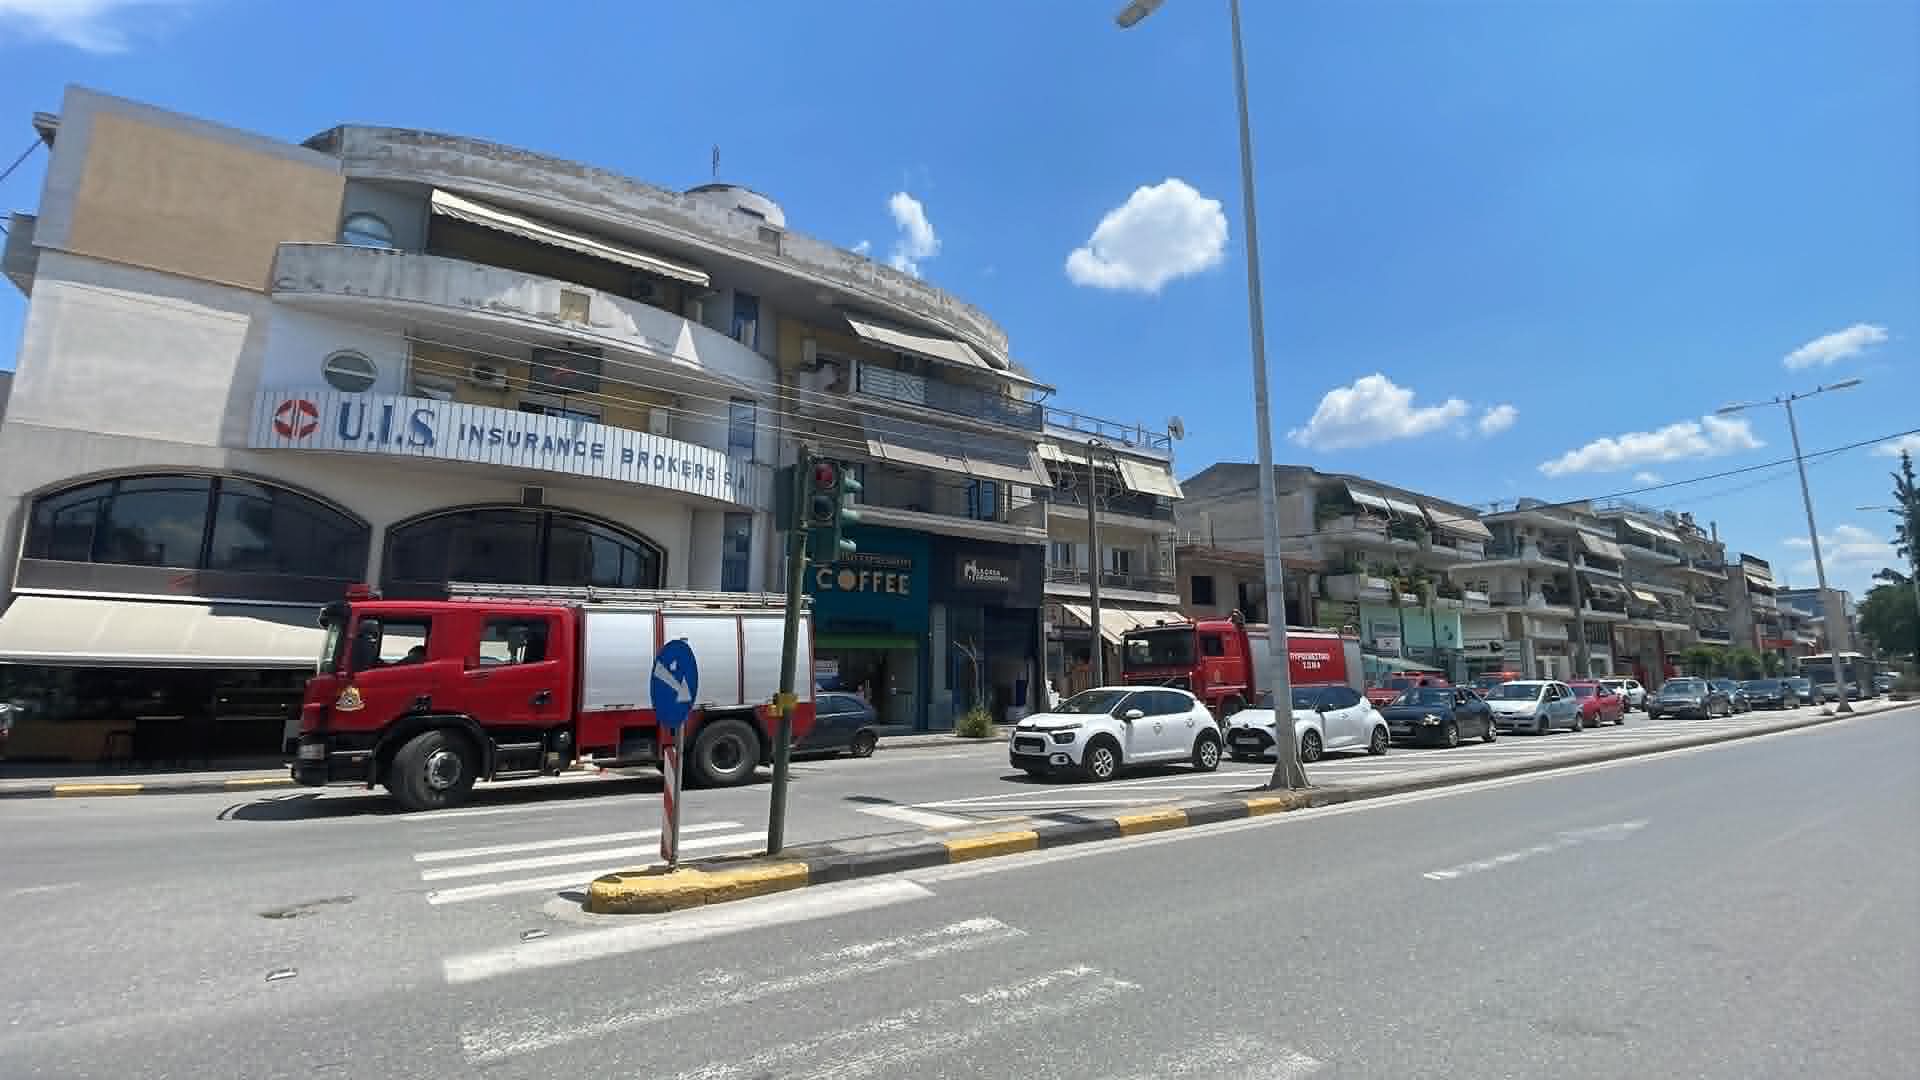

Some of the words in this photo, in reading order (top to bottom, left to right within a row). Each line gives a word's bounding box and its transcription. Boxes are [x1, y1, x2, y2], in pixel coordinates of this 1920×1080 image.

[458, 423, 605, 458] INSURANCE
[622, 447, 715, 480] BROKERS
[815, 567, 911, 596] COFFEE
